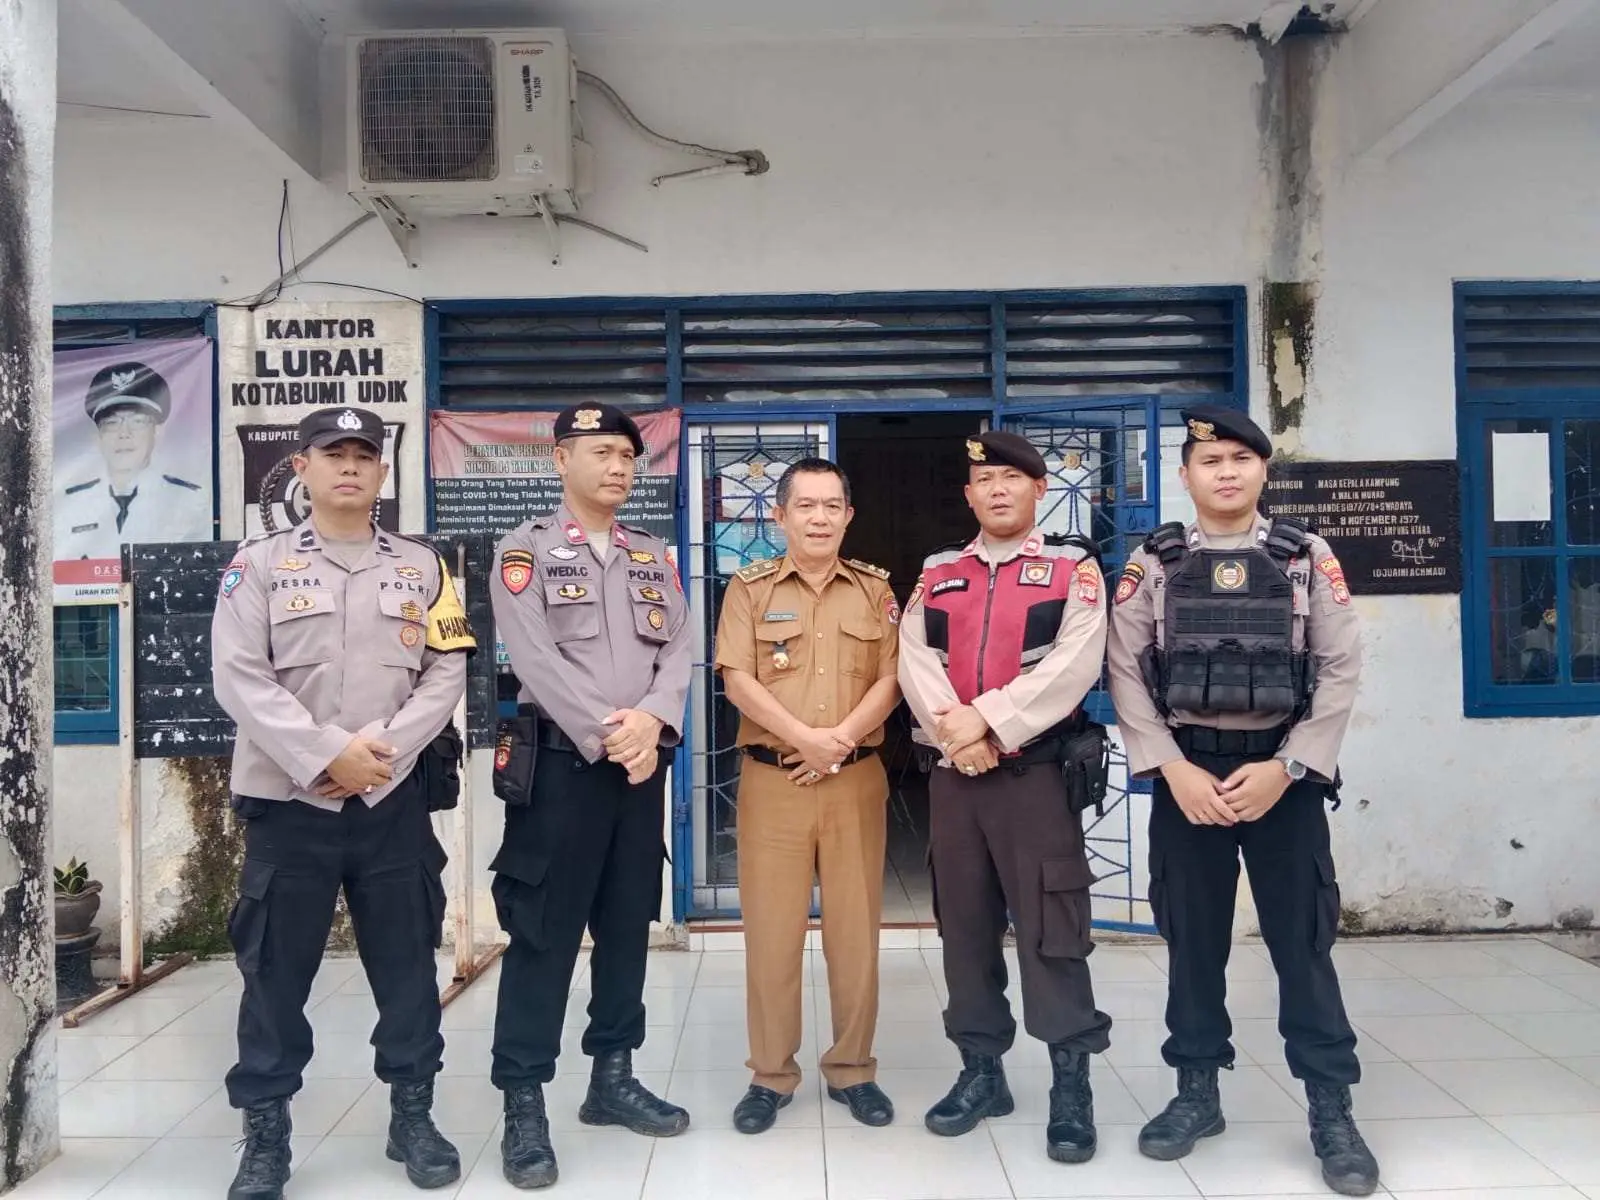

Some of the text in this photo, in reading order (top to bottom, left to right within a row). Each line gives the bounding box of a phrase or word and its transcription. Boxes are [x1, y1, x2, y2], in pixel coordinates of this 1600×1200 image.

[266, 318, 375, 339] KANTOR
[255, 347, 384, 378] LURAH
[232, 380, 409, 407] KOTABUMI UDIK
[248, 431, 300, 442] KABUPATE
[517, 444, 554, 457] PRESIDE
[464, 461, 497, 473] NOMOR
[511, 460, 539, 473] TAHUN
[541, 460, 554, 473] 20
[435, 480, 459, 489] Setiap
[461, 480, 484, 489] Orang
[486, 480, 504, 488] Yang
[539, 480, 562, 488] Tetap
[1318, 479, 1338, 489] MASA
[1365, 478, 1400, 487] KAMPUNG
[500, 492, 519, 500] Yang
[436, 504, 487, 513] Sebagaimana
[644, 500, 669, 508] Sanksi
[1268, 504, 1297, 514] SUMBER
[1399, 515, 1420, 524] 1977
[1318, 528, 1344, 537] BUPATI
[1379, 526, 1409, 536] LAMPUNG
[628, 570, 665, 583] POLRI
[271, 578, 322, 592] DESRA
[380, 581, 430, 597] POLRI
[75, 588, 99, 596] LURAH
